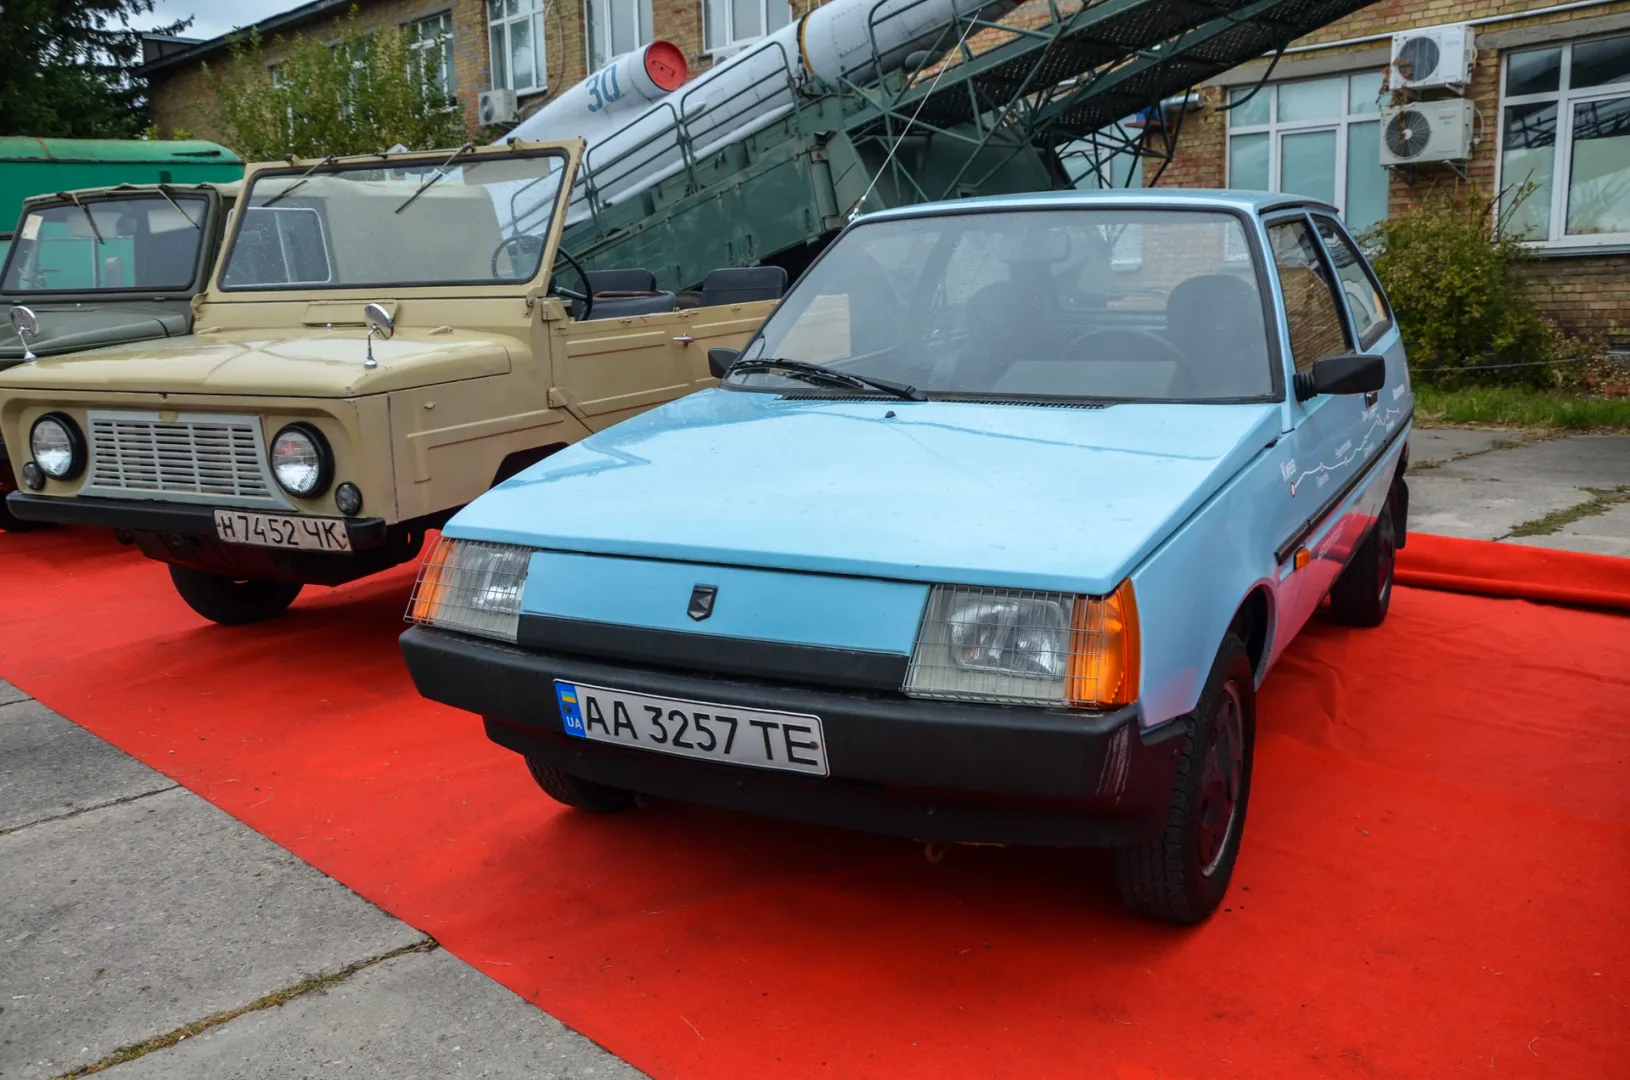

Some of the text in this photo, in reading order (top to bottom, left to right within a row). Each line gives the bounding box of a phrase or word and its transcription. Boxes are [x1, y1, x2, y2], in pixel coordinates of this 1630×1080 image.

[585, 64, 621, 113] 30
[237, 515, 299, 546] 7452
[302, 520, 345, 550] ЧК
[566, 715, 583, 730] UA
[585, 695, 819, 767] AA 3257 TE
